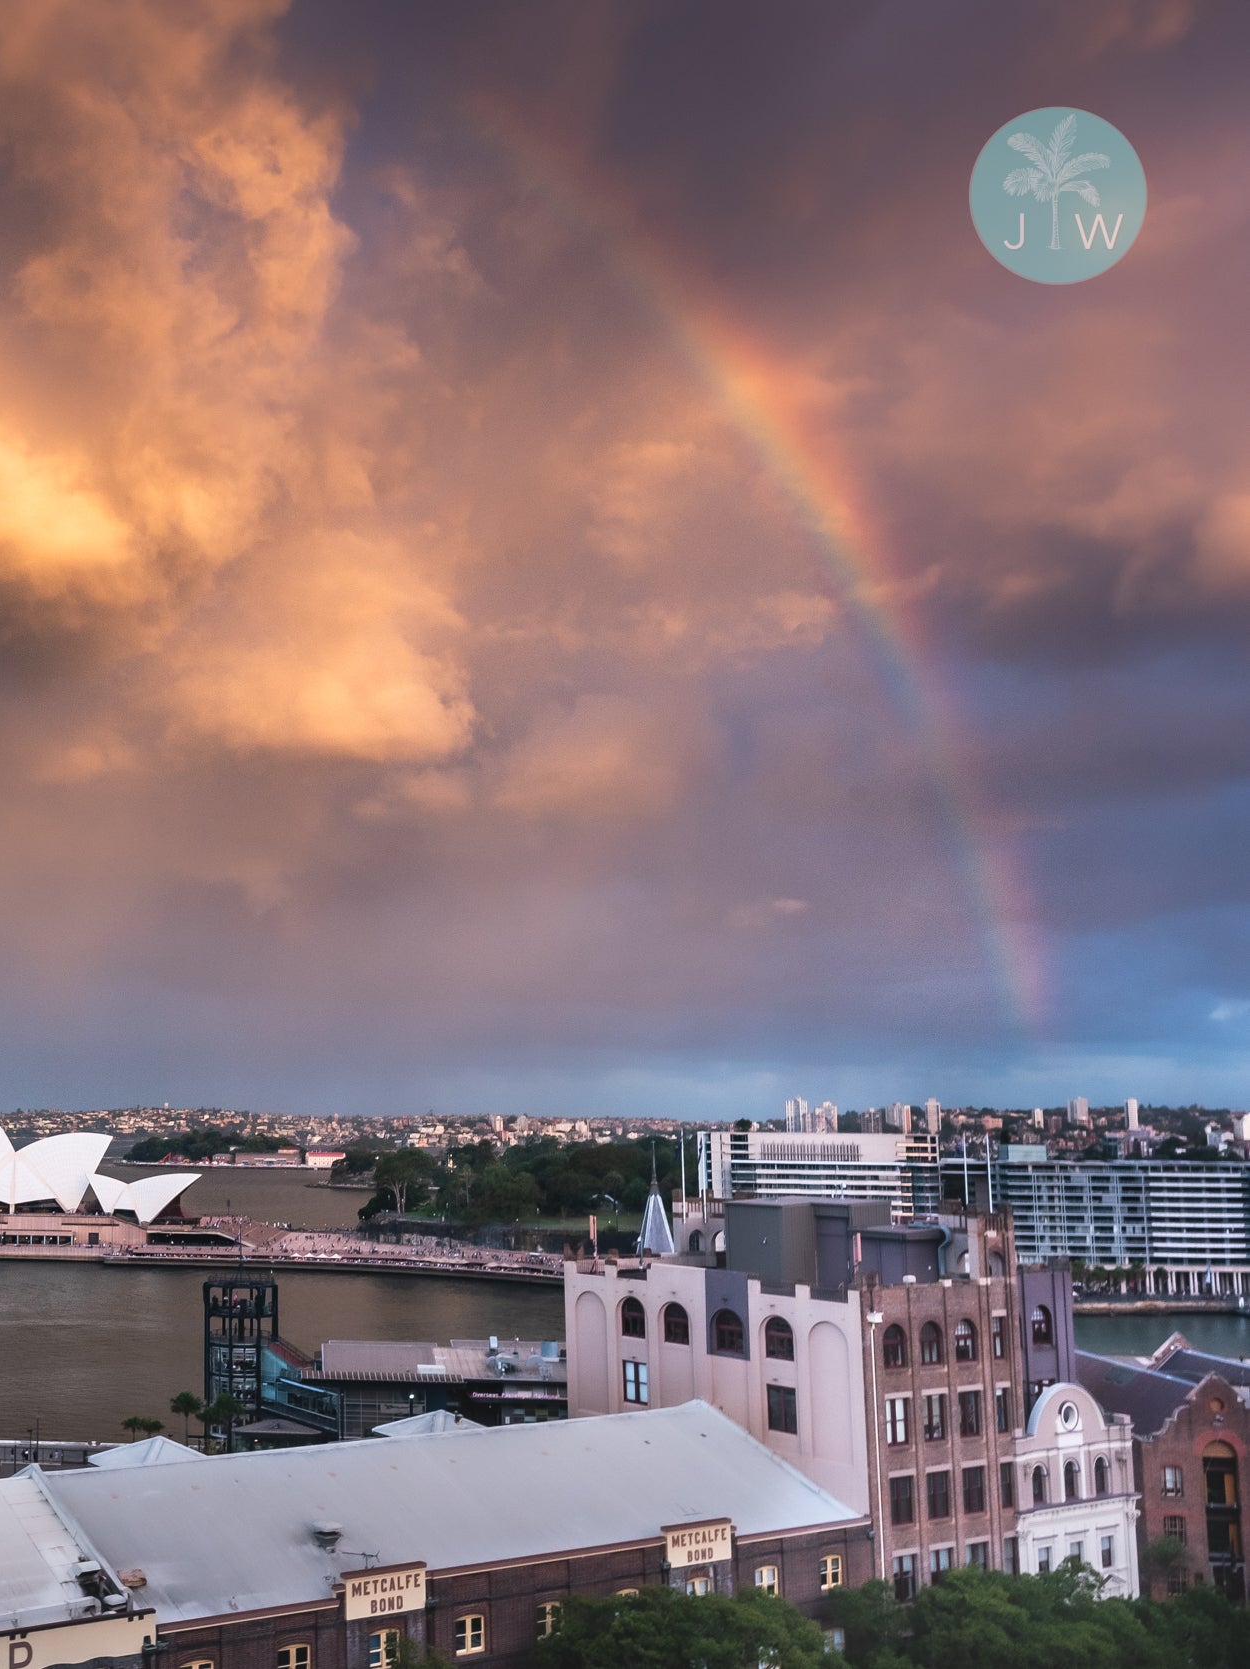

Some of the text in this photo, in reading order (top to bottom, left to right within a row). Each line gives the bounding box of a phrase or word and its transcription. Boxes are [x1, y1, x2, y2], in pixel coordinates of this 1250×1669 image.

[672, 1528, 727, 1548] METCALFE
[687, 1547, 714, 1562] BOND
[352, 1573, 421, 1597] METCALFE
[370, 1595, 404, 1614] BOND
